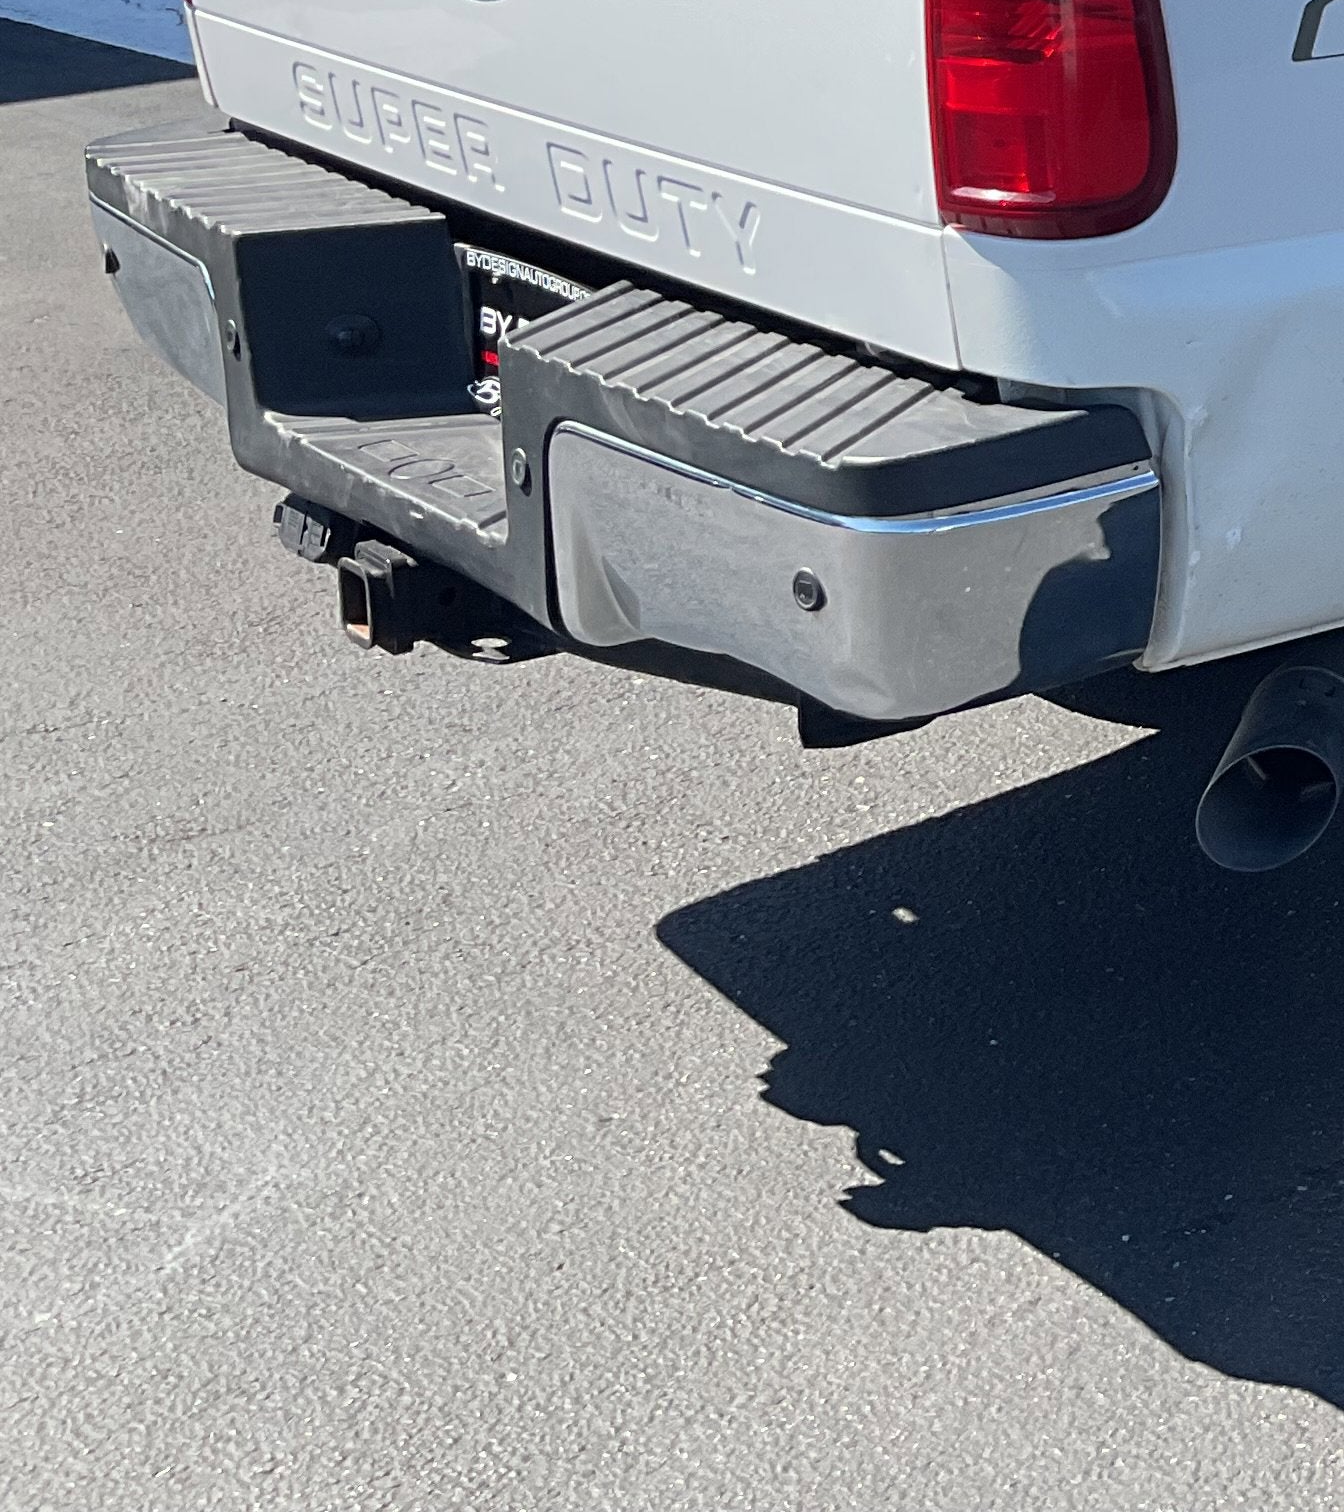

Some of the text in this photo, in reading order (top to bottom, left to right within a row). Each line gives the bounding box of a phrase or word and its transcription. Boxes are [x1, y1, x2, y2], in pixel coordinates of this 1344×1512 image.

[292, 61, 762, 274] SUPER DUTY
[479, 305, 513, 338] BY
